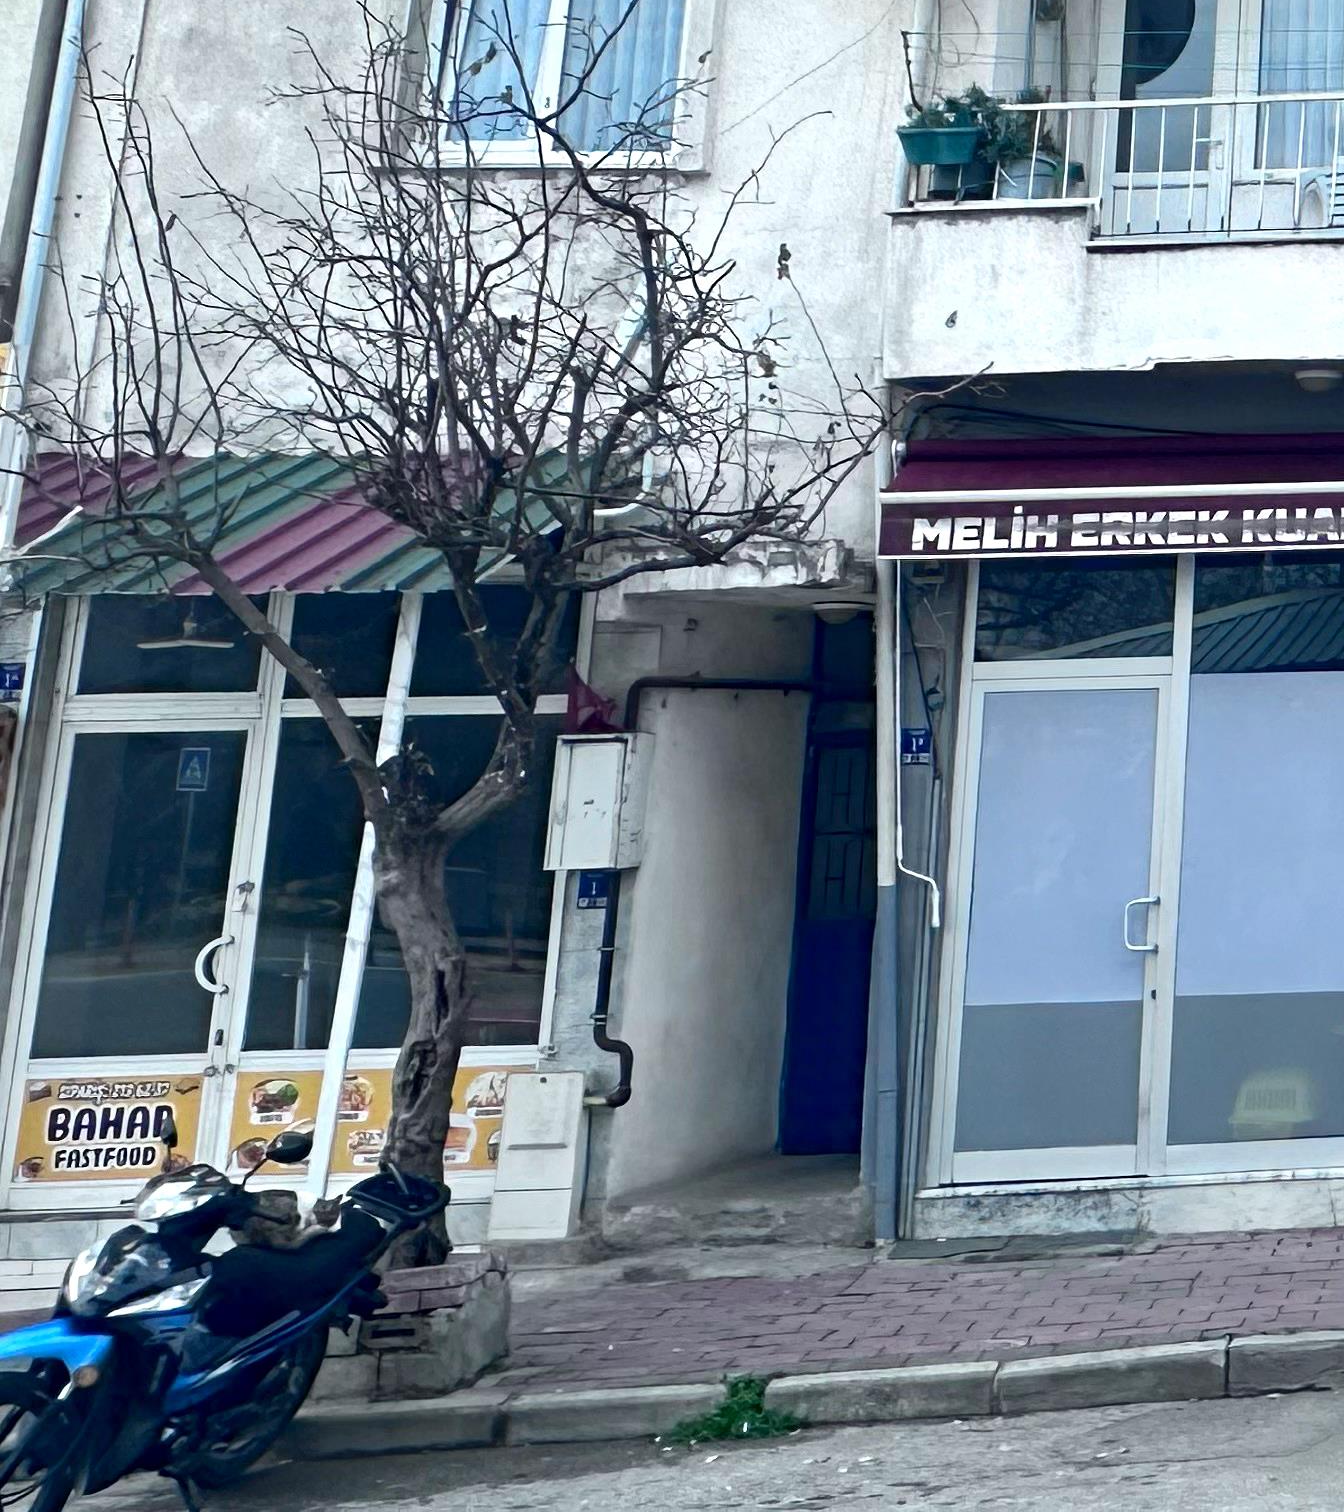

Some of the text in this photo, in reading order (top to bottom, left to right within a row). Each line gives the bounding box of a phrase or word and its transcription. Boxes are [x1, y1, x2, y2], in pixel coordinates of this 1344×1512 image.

[911, 505, 1059, 551] MELİH
[1070, 510, 1231, 548] ERKEK
[54, 1146, 157, 1169] FASTFOOD
